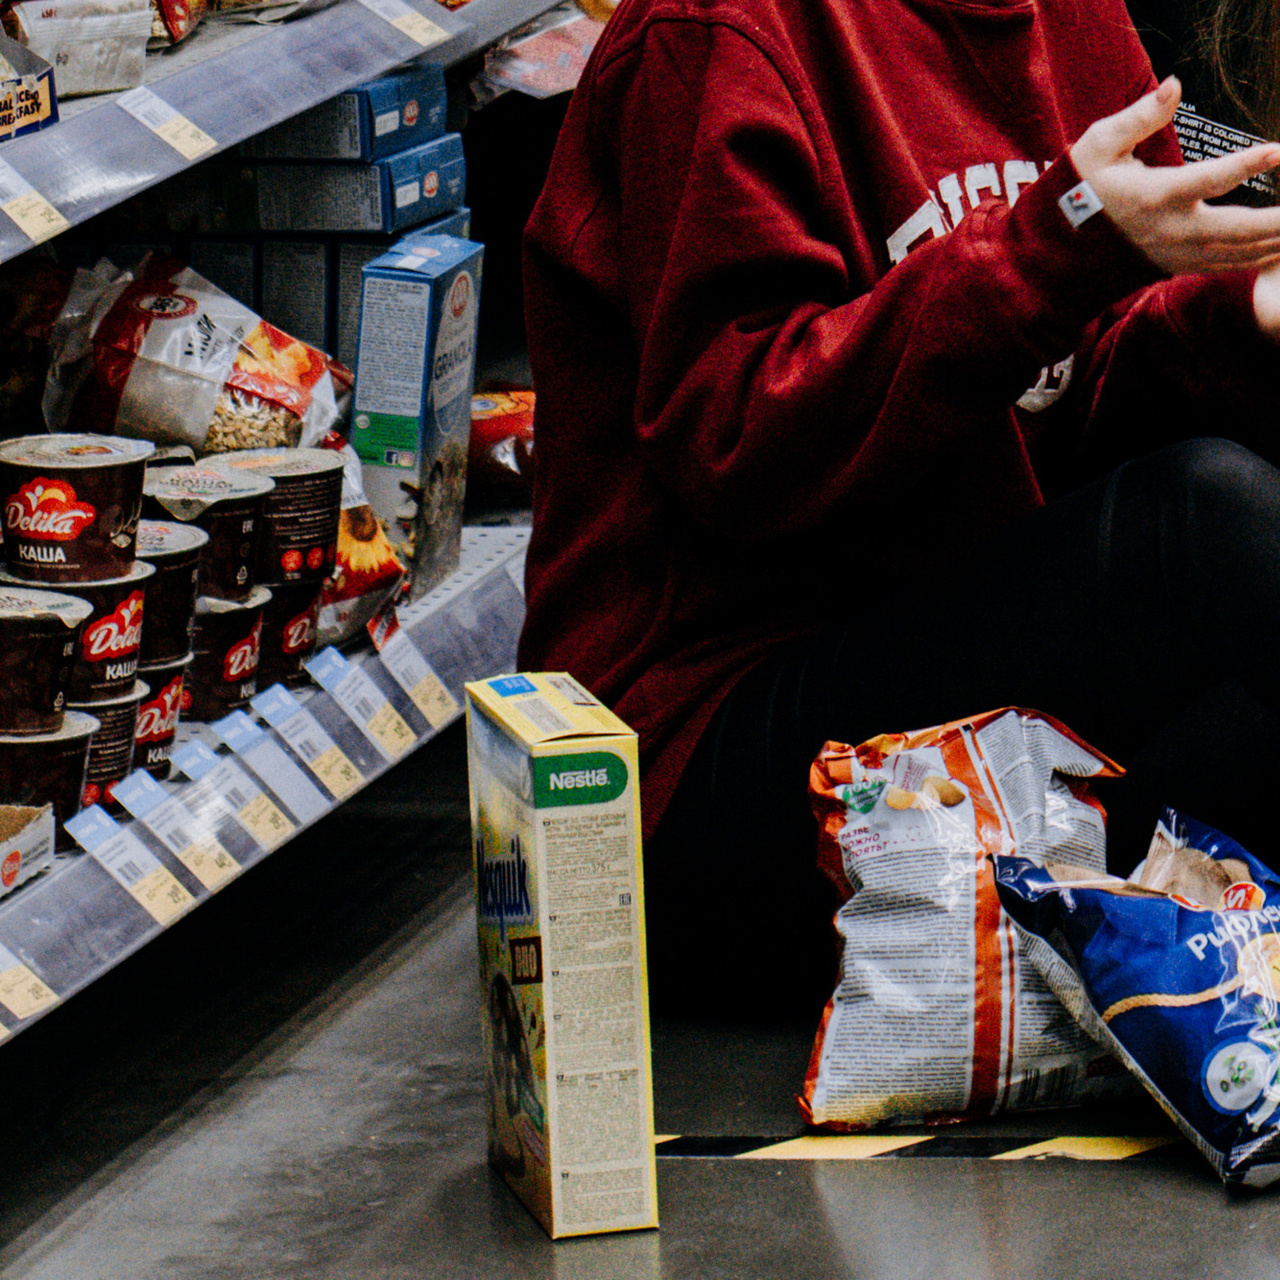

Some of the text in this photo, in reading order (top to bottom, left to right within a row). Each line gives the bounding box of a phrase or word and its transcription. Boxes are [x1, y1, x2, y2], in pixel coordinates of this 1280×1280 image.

[1178, 101, 1196, 112] ALIA
[1173, 114, 1251, 145] T-SHIRT IS COLORED
[1174, 125, 1198, 137] MADE
[1198, 132, 1221, 145] FROM
[1178, 137, 1201, 150] BLES.
[1185, 150, 1203, 161] AND
[5, 501, 84, 535] Delika
[19, 544, 67, 563] КАША
[106, 663, 138, 681] КАШ
[549, 767, 608, 790] Nestlé
